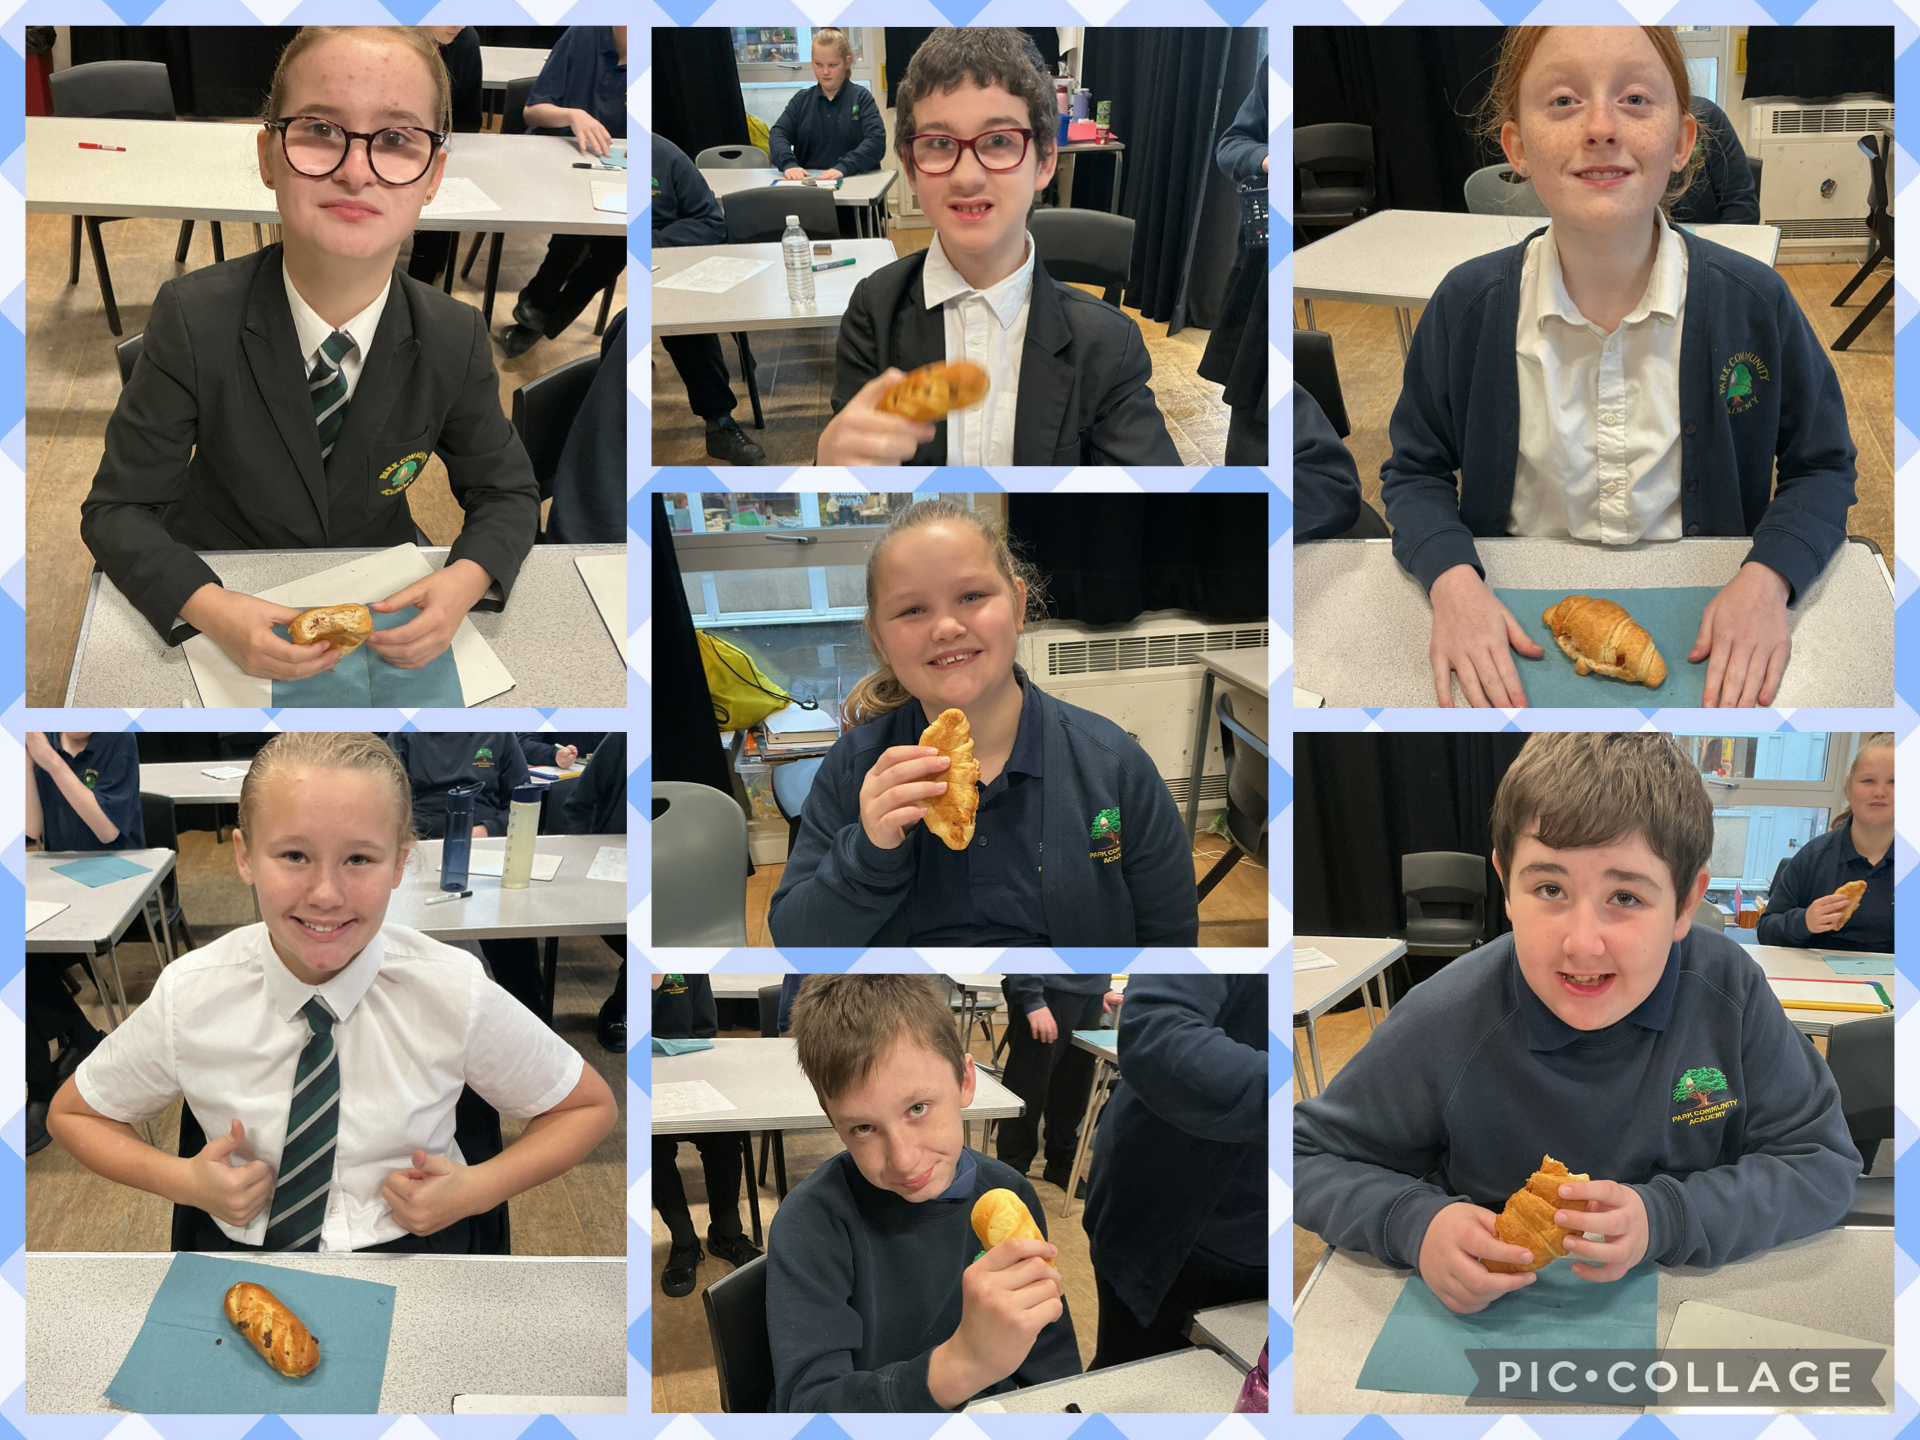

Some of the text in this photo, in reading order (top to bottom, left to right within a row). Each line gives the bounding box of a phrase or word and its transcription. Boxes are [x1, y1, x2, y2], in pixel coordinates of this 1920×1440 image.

[1719, 351, 1770, 395] PARK COMMUNITY
[1089, 851, 1107, 859] PARK
[1672, 1099, 1738, 1123] PARK COMMUNITY
[1689, 1110, 1726, 1125] ACADEMY
